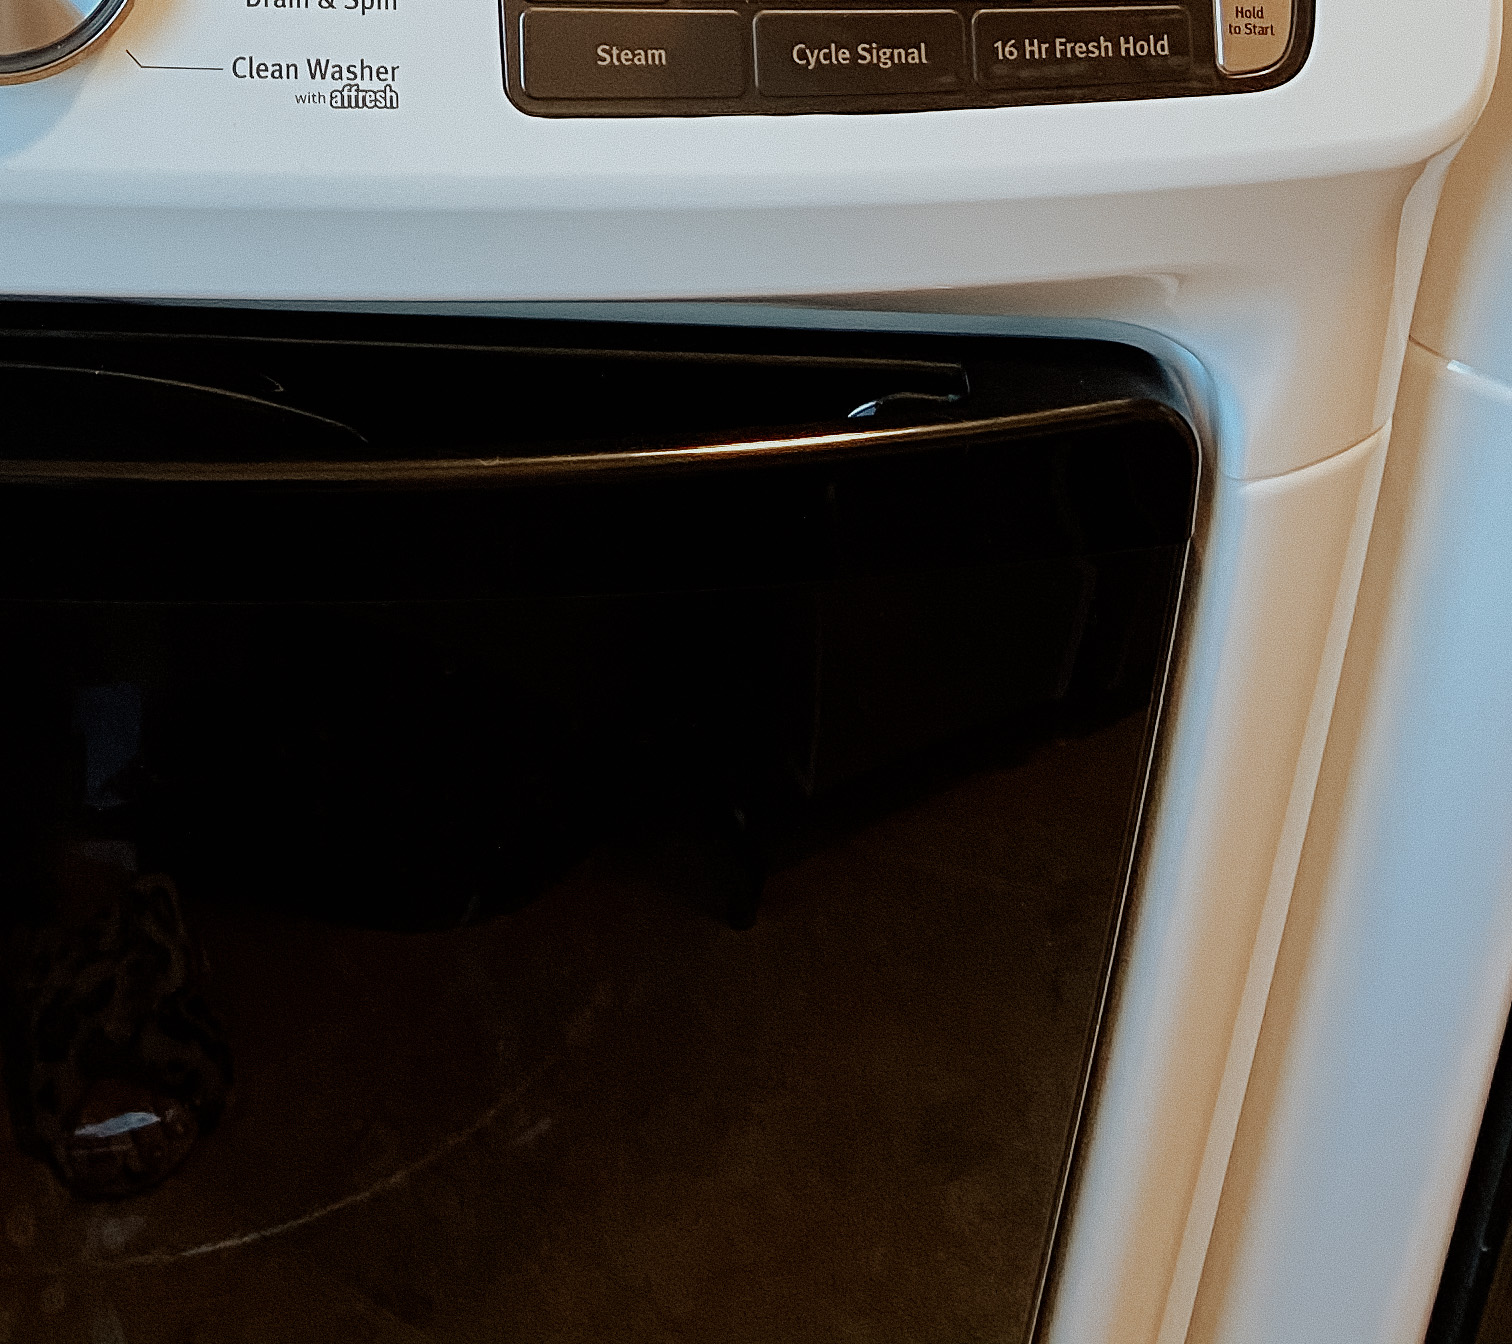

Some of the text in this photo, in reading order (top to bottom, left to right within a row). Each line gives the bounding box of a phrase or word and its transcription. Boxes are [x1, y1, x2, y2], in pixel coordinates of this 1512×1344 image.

[1235, 6, 1264, 20] Hold
[1228, 22, 1275, 37] to Start
[596, 44, 667, 67] Steam
[792, 43, 928, 70] Cycle Signal
[994, 35, 1170, 60] 16 Hr Fresh Hold
[231, 56, 400, 82] Clean Washer
[295, 83, 399, 109] with affresh
